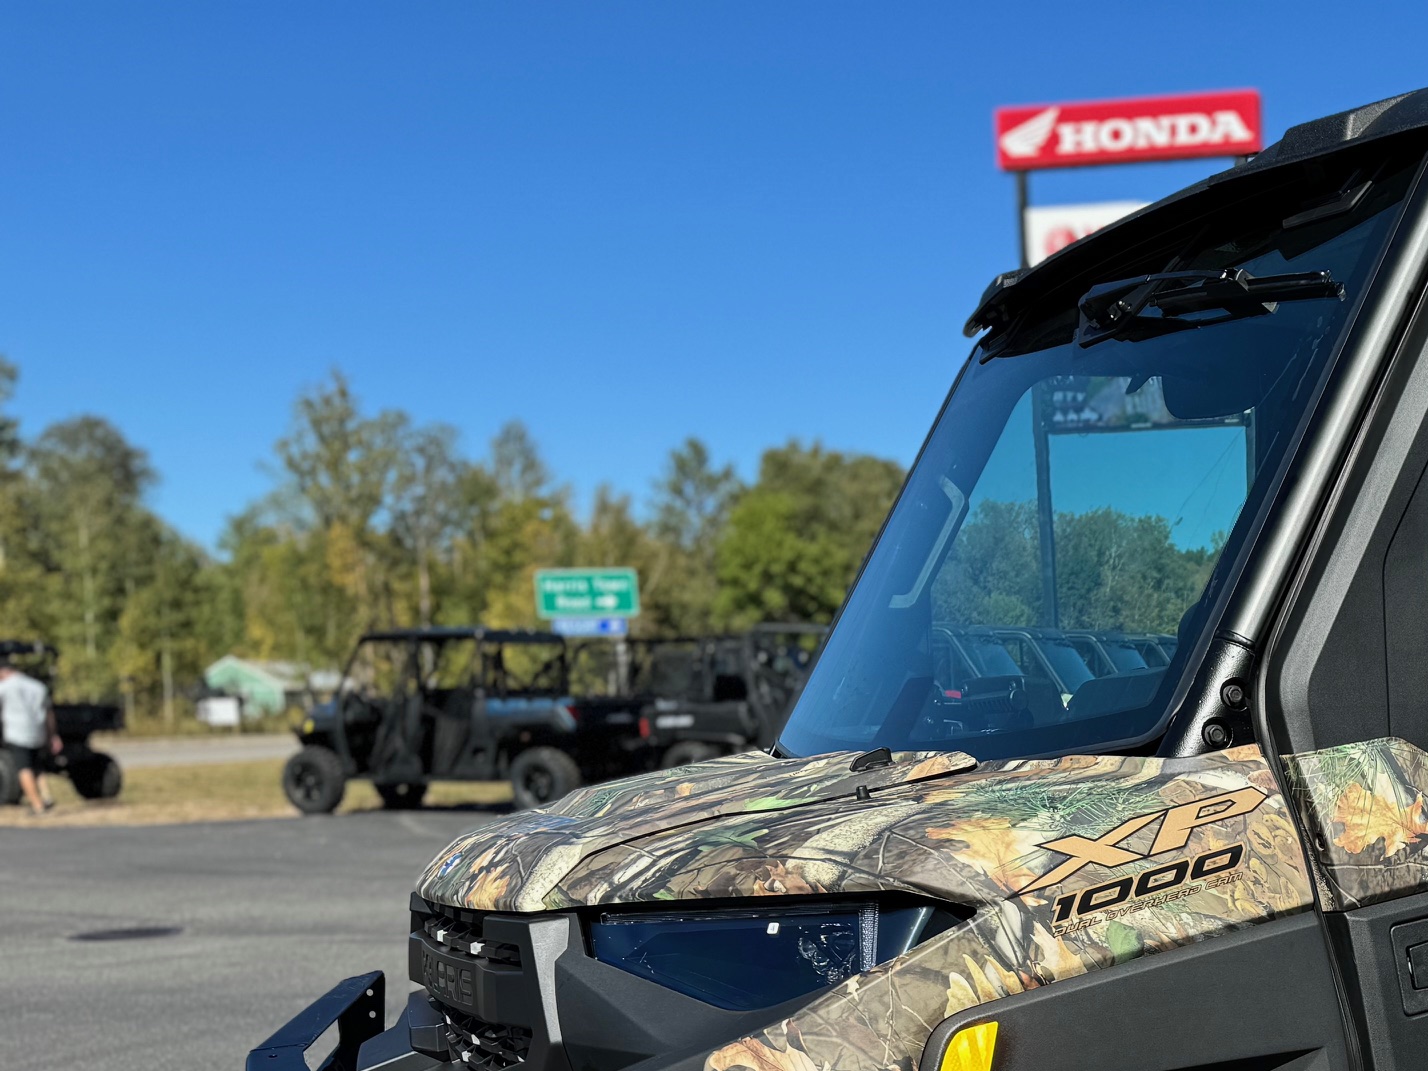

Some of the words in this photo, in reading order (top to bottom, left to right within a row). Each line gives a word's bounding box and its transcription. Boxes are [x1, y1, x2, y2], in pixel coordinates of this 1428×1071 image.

[1055, 109, 1255, 155] HONDA
[1003, 786, 1268, 901] XP
[1050, 843, 1245, 926] 1000
[1053, 917, 1102, 938] DUAL
[1106, 884, 1202, 922] OVERHEAD
[1204, 871, 1244, 890] CAM
